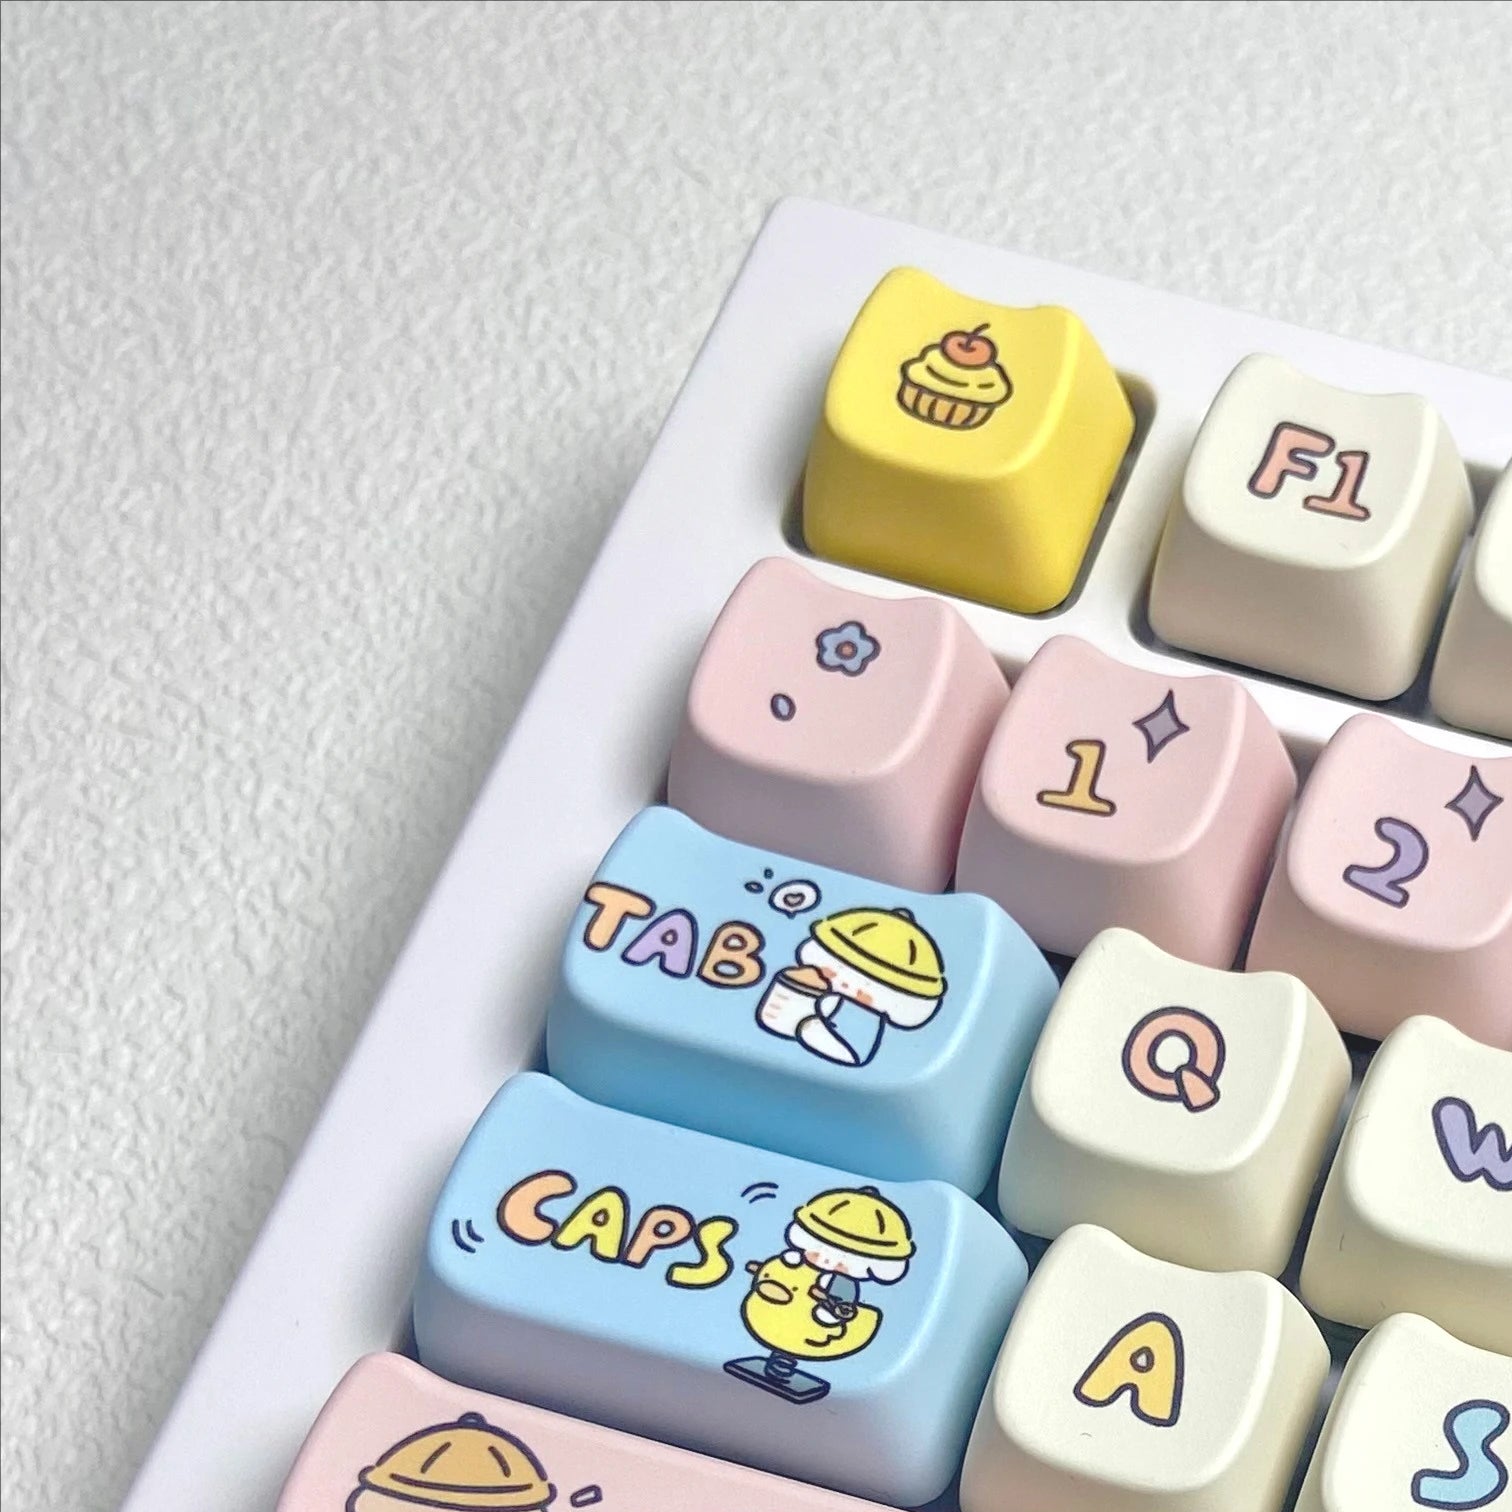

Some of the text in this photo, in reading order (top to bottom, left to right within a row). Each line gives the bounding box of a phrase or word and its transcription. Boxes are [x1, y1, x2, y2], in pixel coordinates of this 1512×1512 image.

[1248, 422, 1370, 521] F1
[1037, 739, 1116, 817] 1
[1342, 816, 1430, 909] 2
[583, 882, 768, 989] TAB
[1122, 1006, 1226, 1113] Q
[497, 1170, 740, 1290] CAPS
[1073, 1312, 1184, 1427] A
[1411, 1400, 1510, 1511] S
